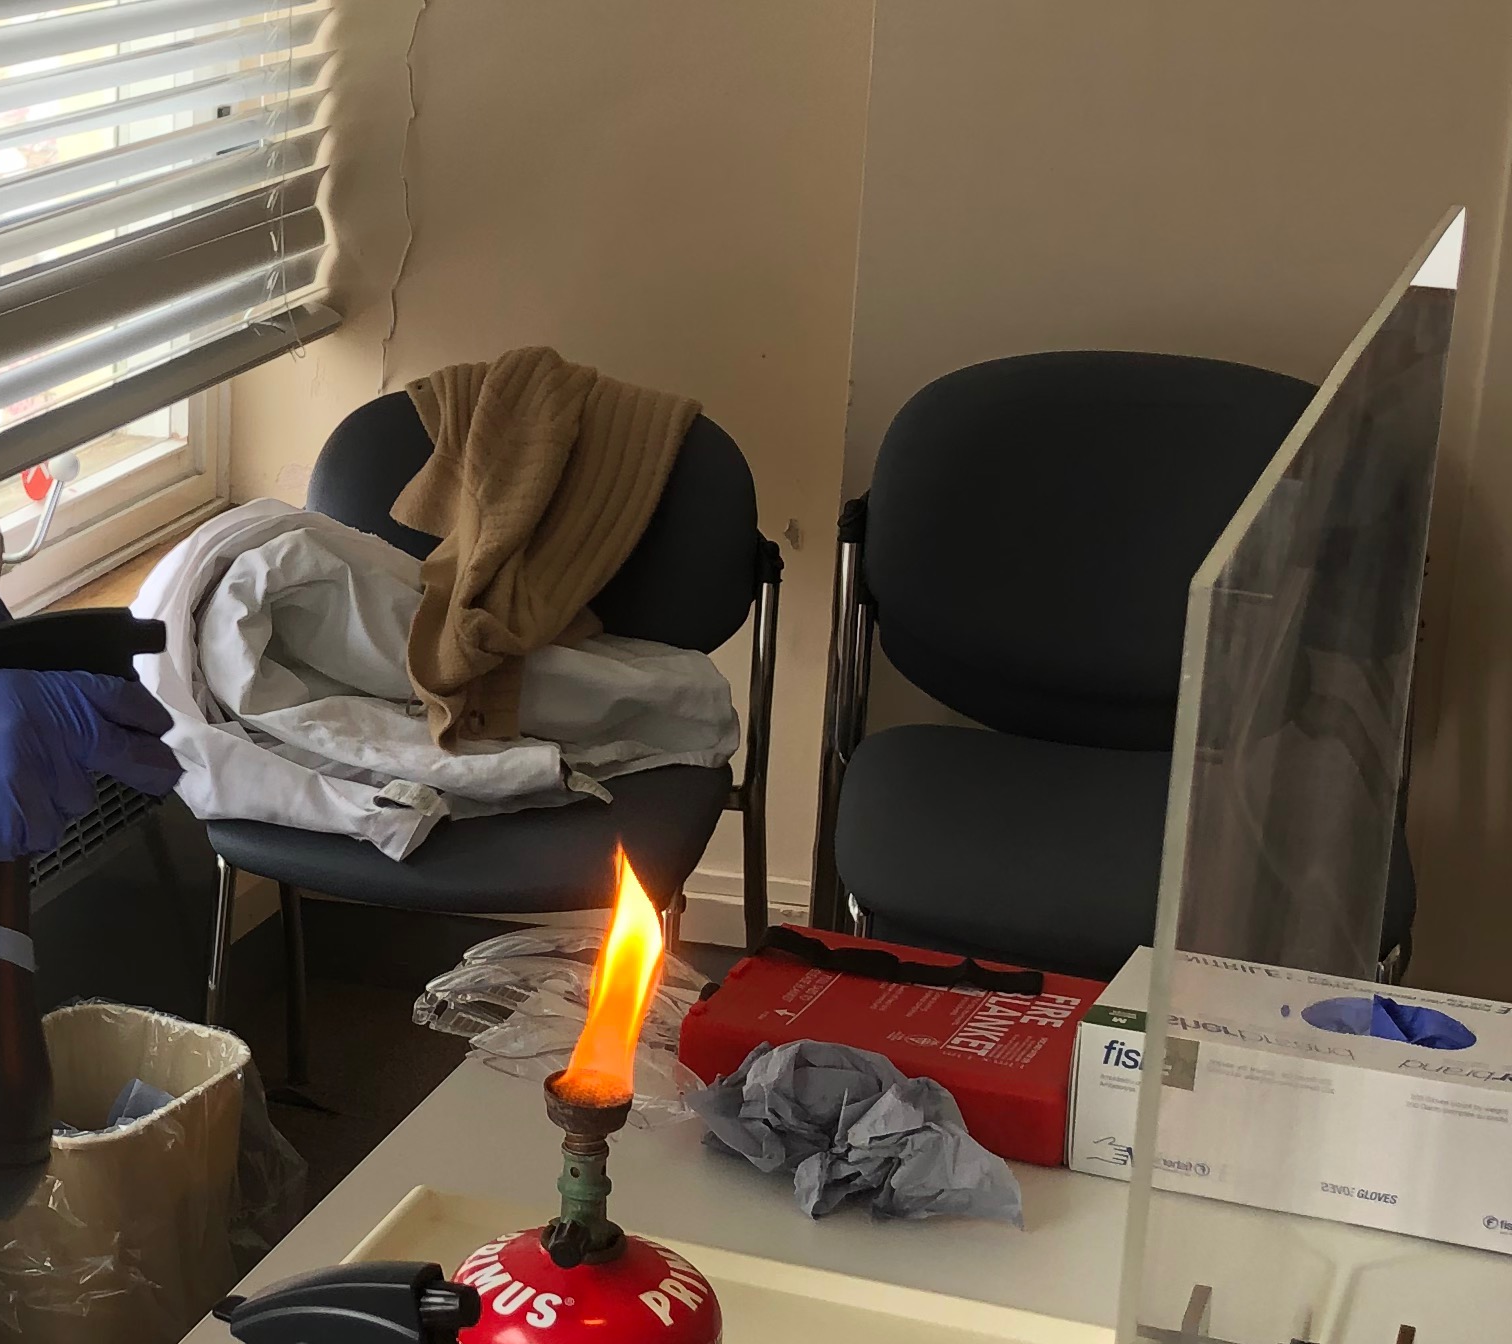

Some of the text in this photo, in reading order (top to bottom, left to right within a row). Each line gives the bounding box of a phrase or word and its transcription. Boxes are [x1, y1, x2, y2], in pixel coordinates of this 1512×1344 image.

[1020, 993, 1081, 1028] FIRE
[1102, 1039, 1143, 1070] fis
[1356, 1189, 1398, 1204] GLOVES
